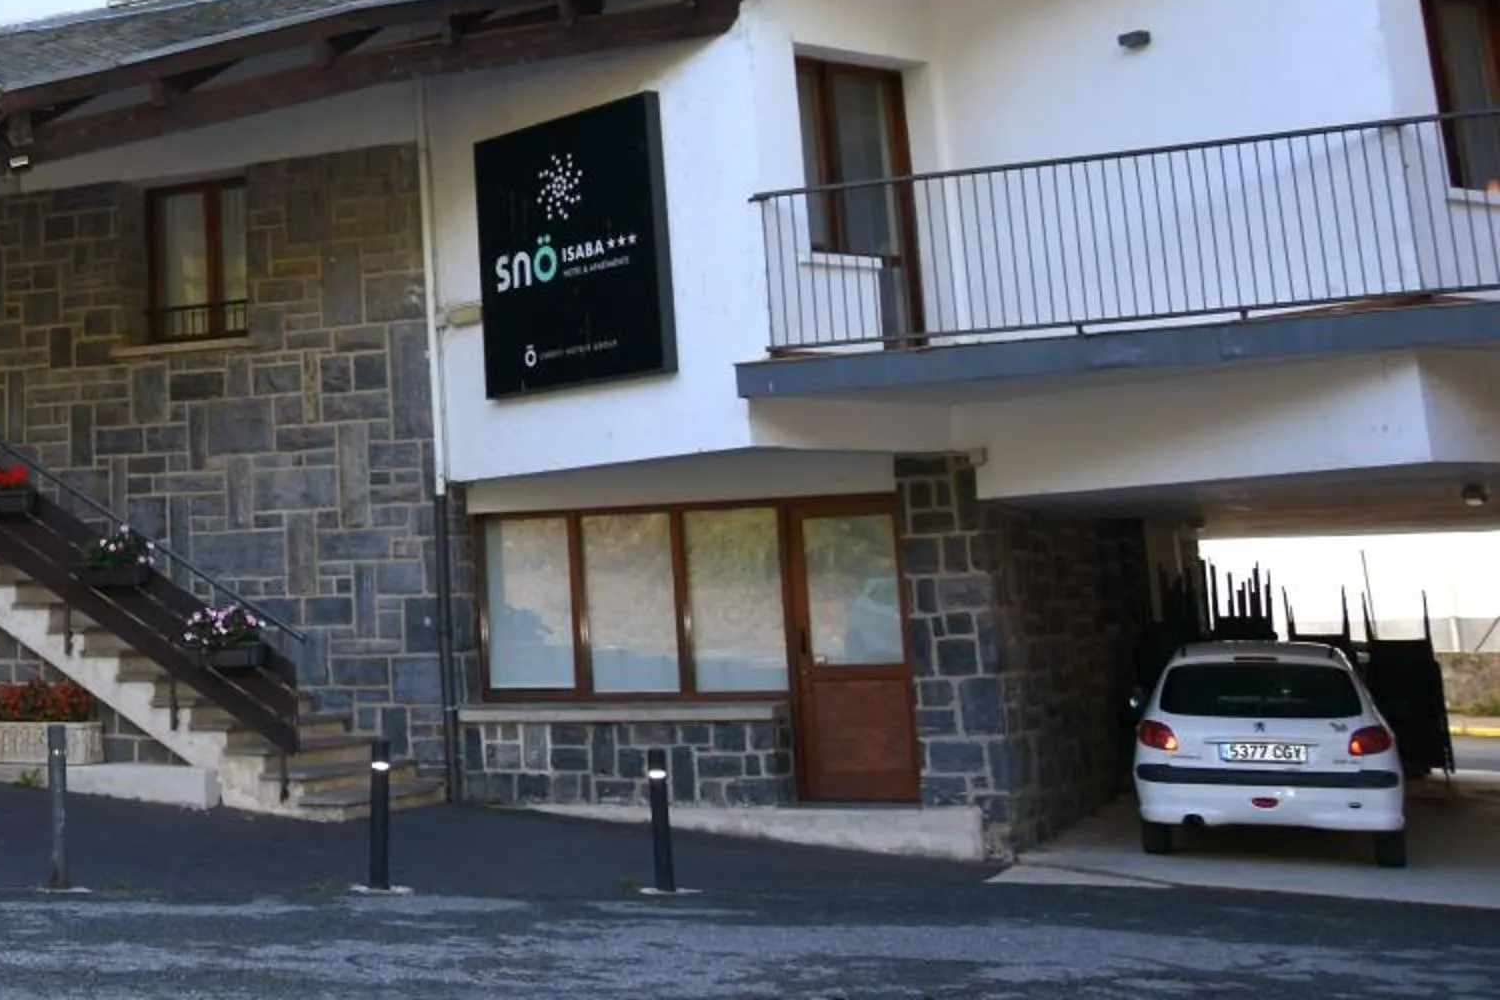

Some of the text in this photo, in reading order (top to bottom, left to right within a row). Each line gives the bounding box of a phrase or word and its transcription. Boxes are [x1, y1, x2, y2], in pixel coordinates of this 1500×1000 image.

[561, 239, 605, 263] ISABA
[1230, 744, 1301, 759] 5377 CGY
